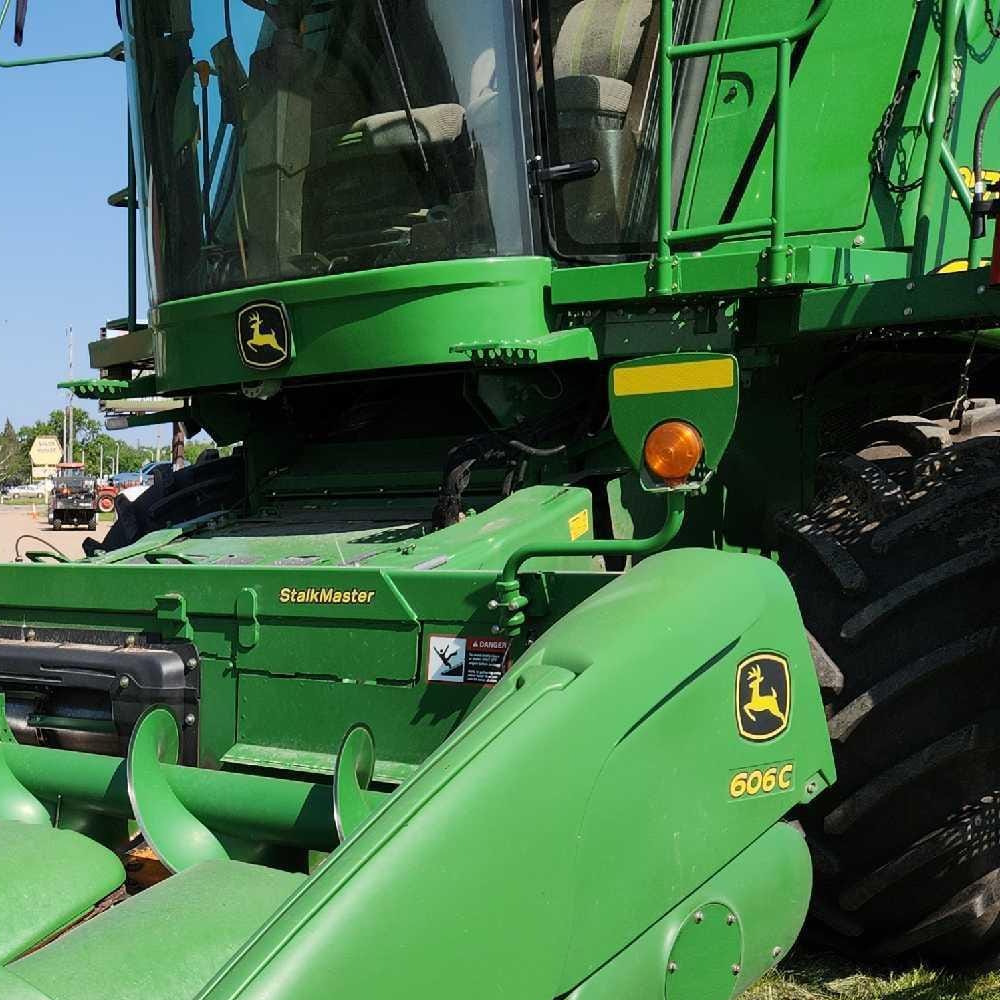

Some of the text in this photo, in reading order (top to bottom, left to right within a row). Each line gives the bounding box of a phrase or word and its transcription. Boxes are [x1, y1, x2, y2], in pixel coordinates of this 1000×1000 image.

[279, 587, 375, 603] StalkMaster
[479, 641, 507, 649] DANGER
[729, 763, 793, 798] 606C
